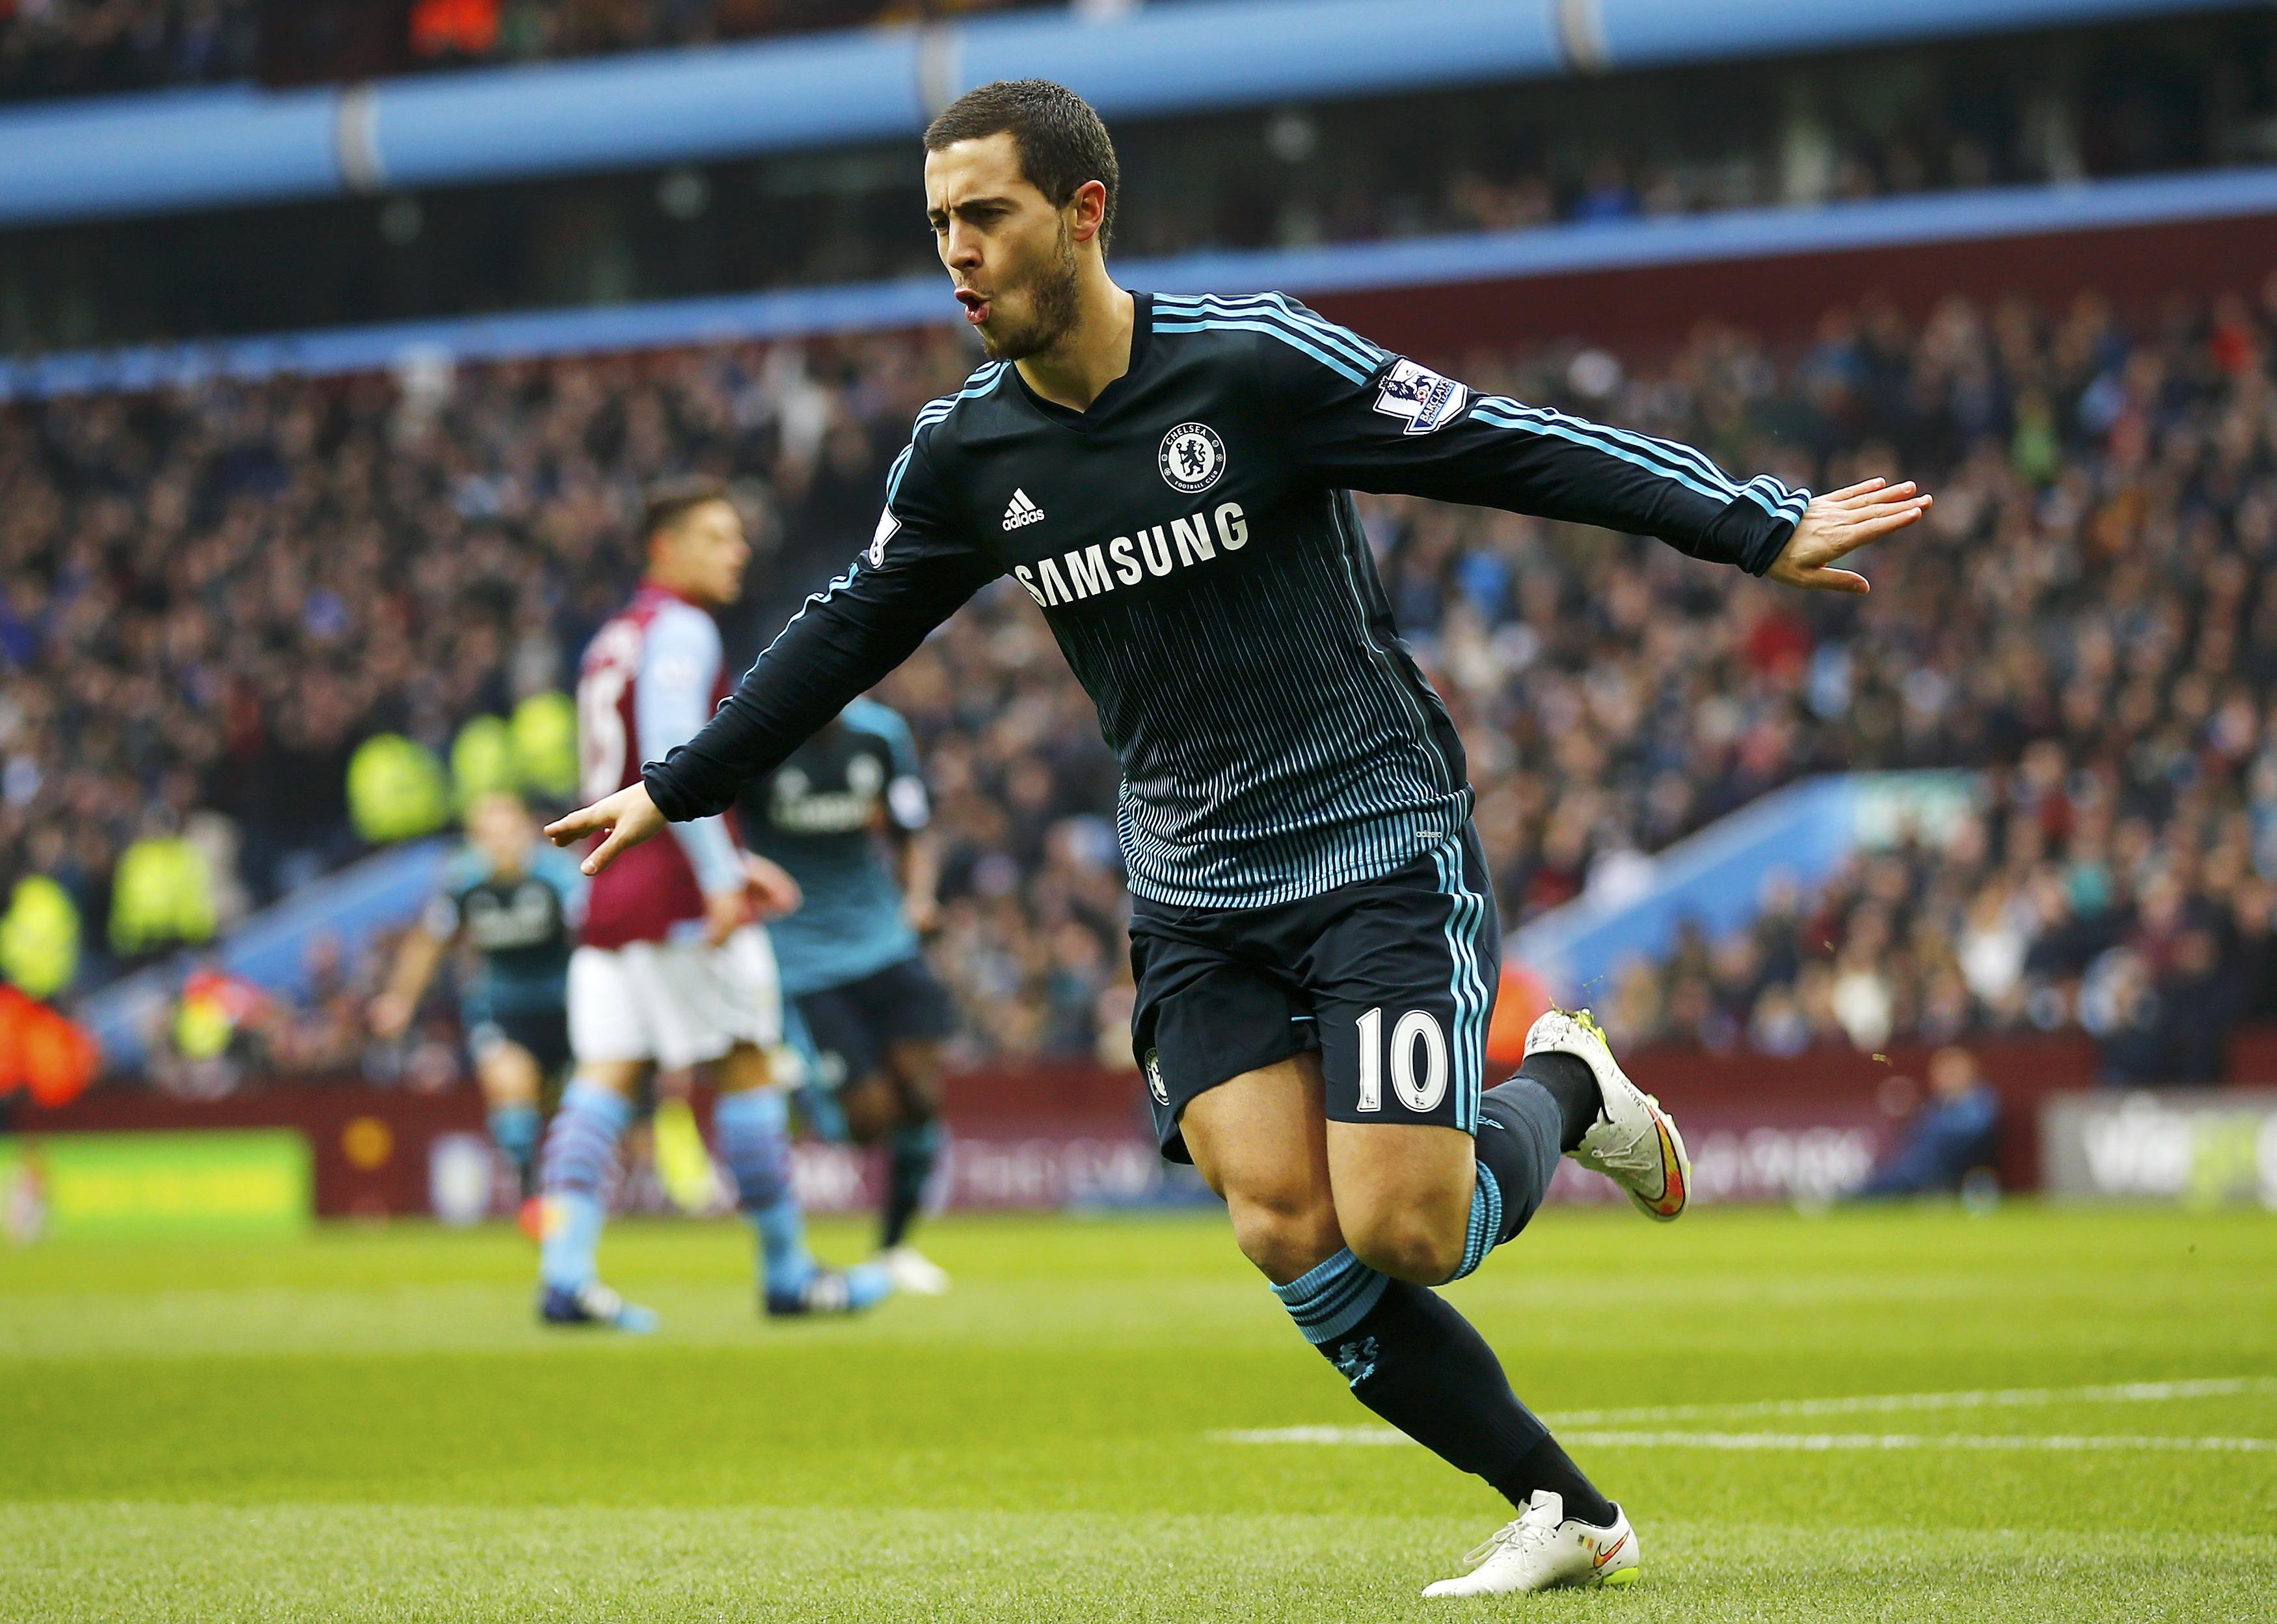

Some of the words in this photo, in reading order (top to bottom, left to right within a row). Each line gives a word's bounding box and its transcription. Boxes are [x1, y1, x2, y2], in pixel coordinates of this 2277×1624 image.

[1419, 378, 1449, 422] BARCLAYS
[1166, 425, 1207, 445] CHELSEA
[1174, 480, 1205, 489] FOOTBALL
[1205, 470, 1218, 483] CLUB
[1003, 508, 1045, 531] adidas
[1015, 502, 1248, 608] SAMSUNG
[1356, 1007, 1448, 1113] 10
